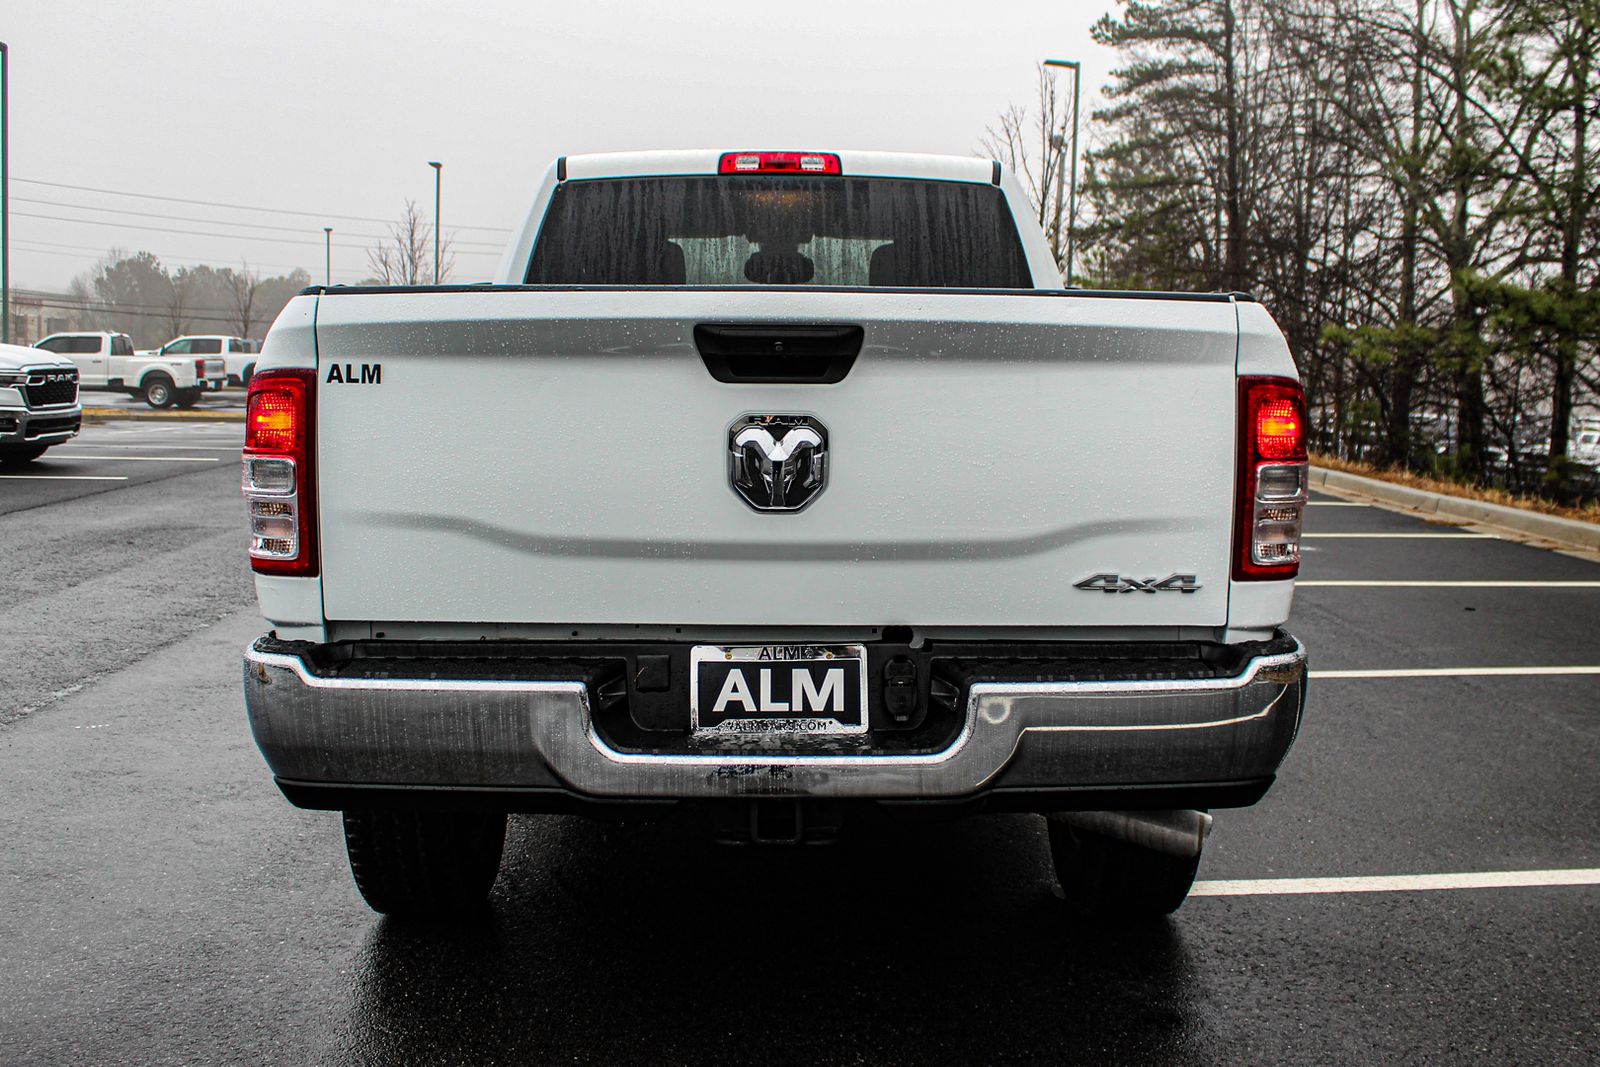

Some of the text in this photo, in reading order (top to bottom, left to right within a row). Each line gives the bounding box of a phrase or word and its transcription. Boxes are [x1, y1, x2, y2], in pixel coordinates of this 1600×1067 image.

[46, 373, 75, 383] RAM
[326, 363, 382, 385] ALM
[1072, 573, 1202, 593] 4x4
[712, 668, 845, 712] ALM
